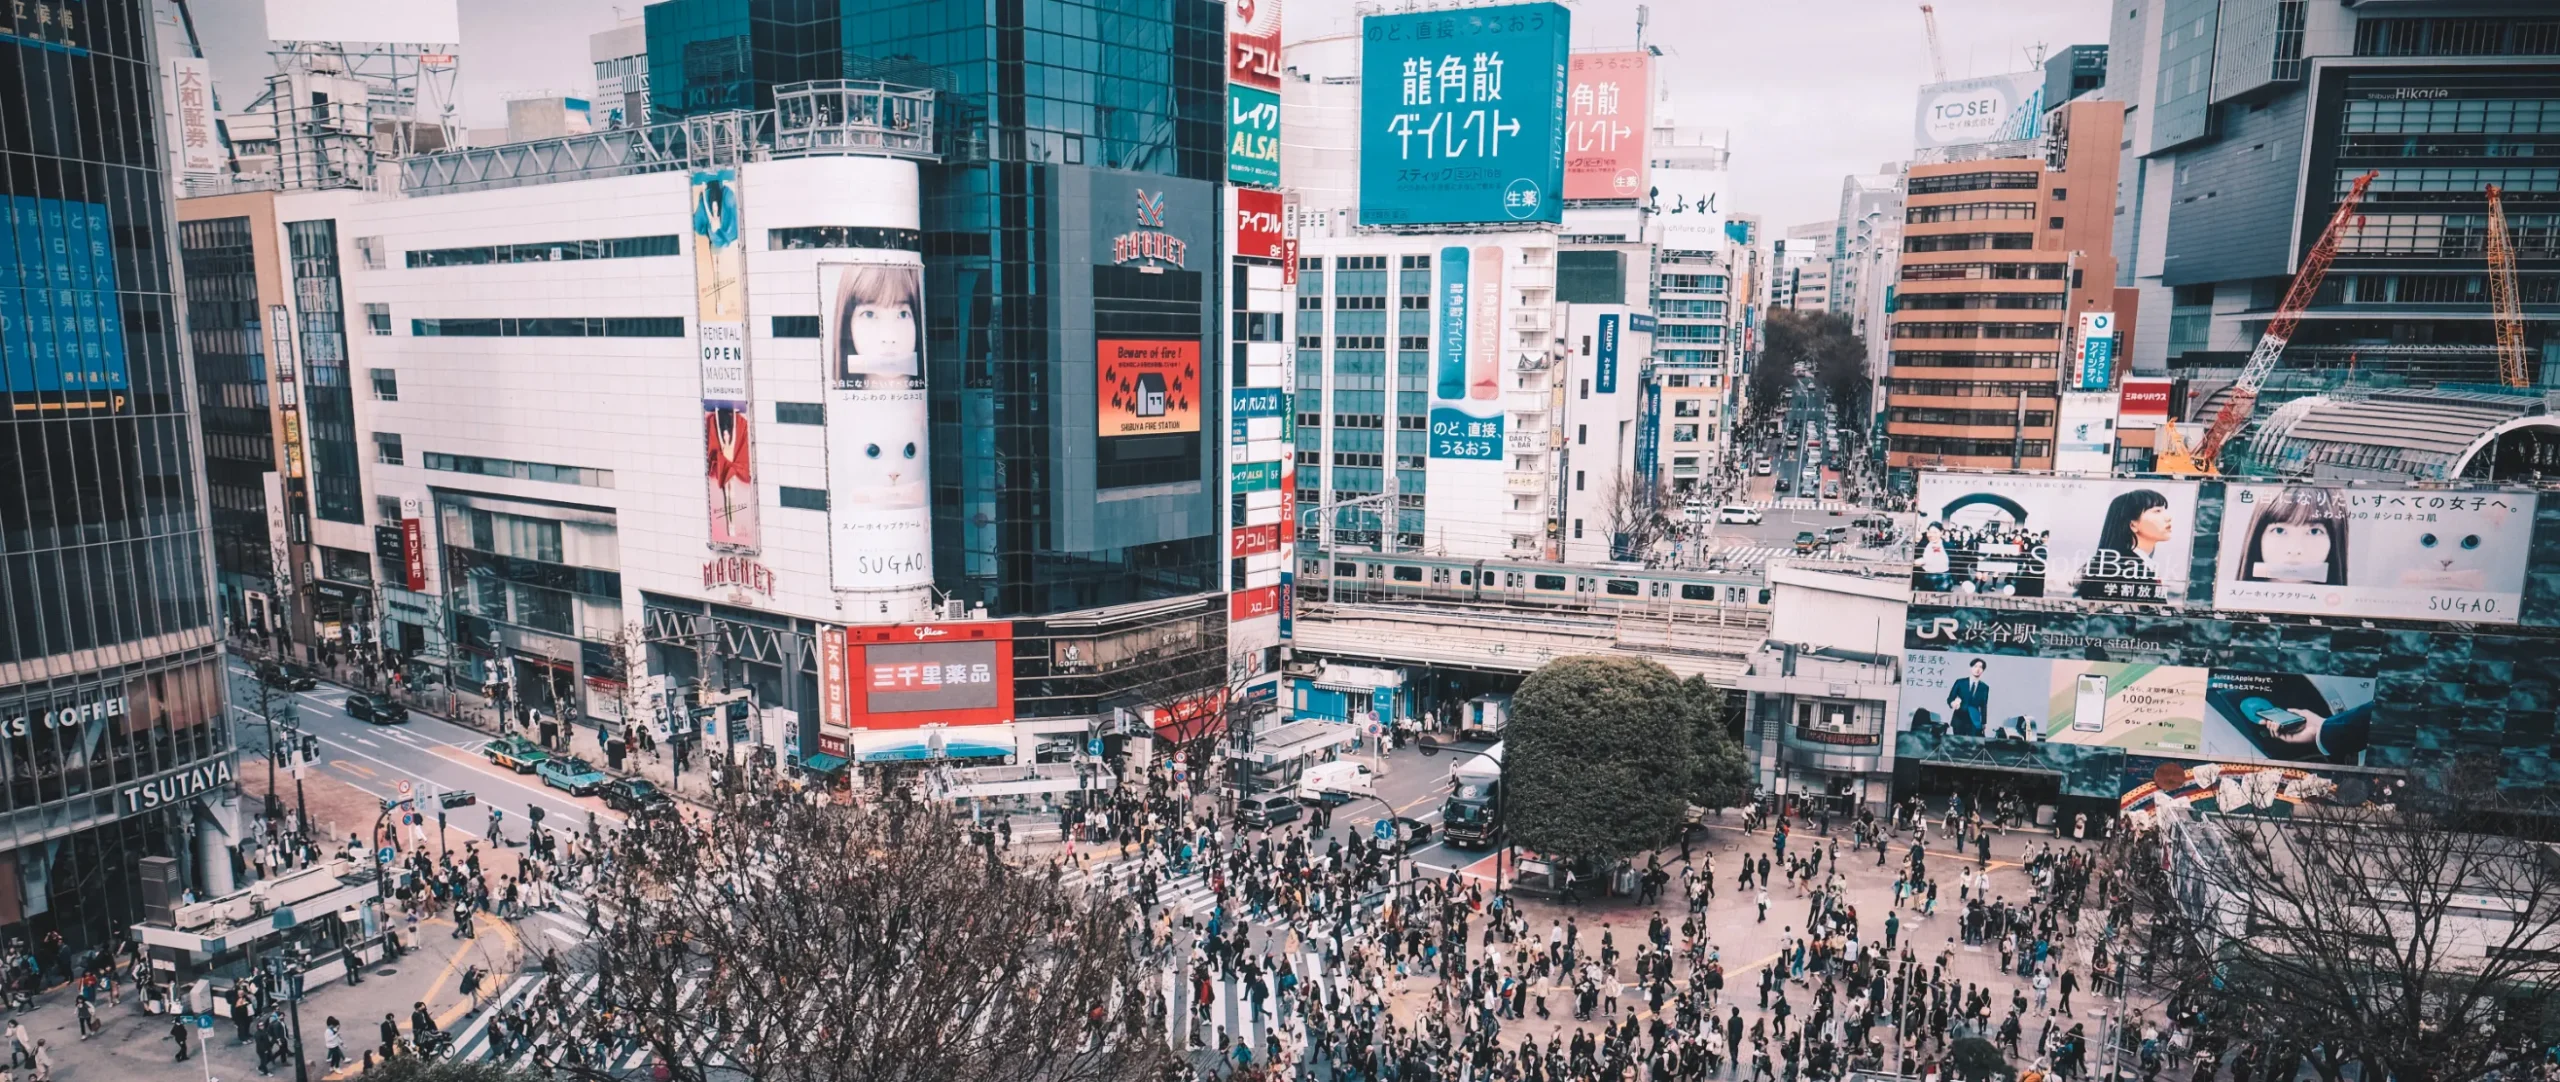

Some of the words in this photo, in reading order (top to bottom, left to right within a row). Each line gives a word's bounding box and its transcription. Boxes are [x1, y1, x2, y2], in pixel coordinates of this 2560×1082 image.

[1237, 43, 1280, 78] アコム
[1403, 51, 1504, 106] 龍角散
[2395, 88, 2448, 99] Hikarie
[179, 67, 208, 148] 大和証券
[1233, 97, 1278, 131] レイク
[1935, 99, 1997, 119] TOSEI
[1388, 110, 1520, 159] ダイレクト
[1231, 131, 1278, 162] ALSA
[1397, 168, 1453, 182] スティック
[1456, 169, 1480, 180] ミント
[1506, 190, 1538, 207] 生薬
[1239, 210, 1281, 233] アイフル
[1113, 231, 1186, 268] MAGNET
[1270, 245, 1281, 257] 8F
[1286, 250, 1295, 283] アイフル
[704, 327, 740, 340] RENEWAL
[1606, 320, 1614, 352] MIZUHO
[704, 347, 741, 360] OPEN
[1118, 346, 1147, 358] Beware
[1150, 347, 1158, 358] of
[1161, 346, 1176, 358] fire
[2087, 341, 2099, 383] アイシティ
[2096, 341, 2107, 383] コンタクトの
[706, 367, 741, 380] MAGNET
[843, 393, 886, 401] ふわふわの
[1121, 422, 1143, 431] SHIBUYA
[1145, 422, 1157, 430] FIRE
[1158, 421, 1180, 429] STATION
[1434, 421, 1502, 438] のど、直接、
[1440, 441, 1491, 456] うるおう
[2240, 489, 2518, 513] 色白になりたいすべての女子へ。
[2311, 509, 2368, 520] ふわふわの
[2374, 512, 2437, 523] #シロネコ肌
[1235, 533, 1265, 549] アコム
[2028, 546, 2178, 580] SoftBank
[703, 556, 776, 600] MAGNET
[2104, 583, 2167, 598] 学割放題
[1283, 584, 1291, 620] PROMISE
[1916, 617, 1959, 640] JR
[1965, 620, 2036, 644] 渋谷駅
[2041, 633, 2102, 649] shibuya
[2107, 637, 2160, 651] station
[1908, 653, 1950, 666] 新生活も、
[873, 664, 991, 686] 三千里薬品
[1907, 666, 1944, 676] スイスイ
[1906, 677, 1947, 689] 行こうぜ。
[124, 761, 232, 812] TSUTAYA
